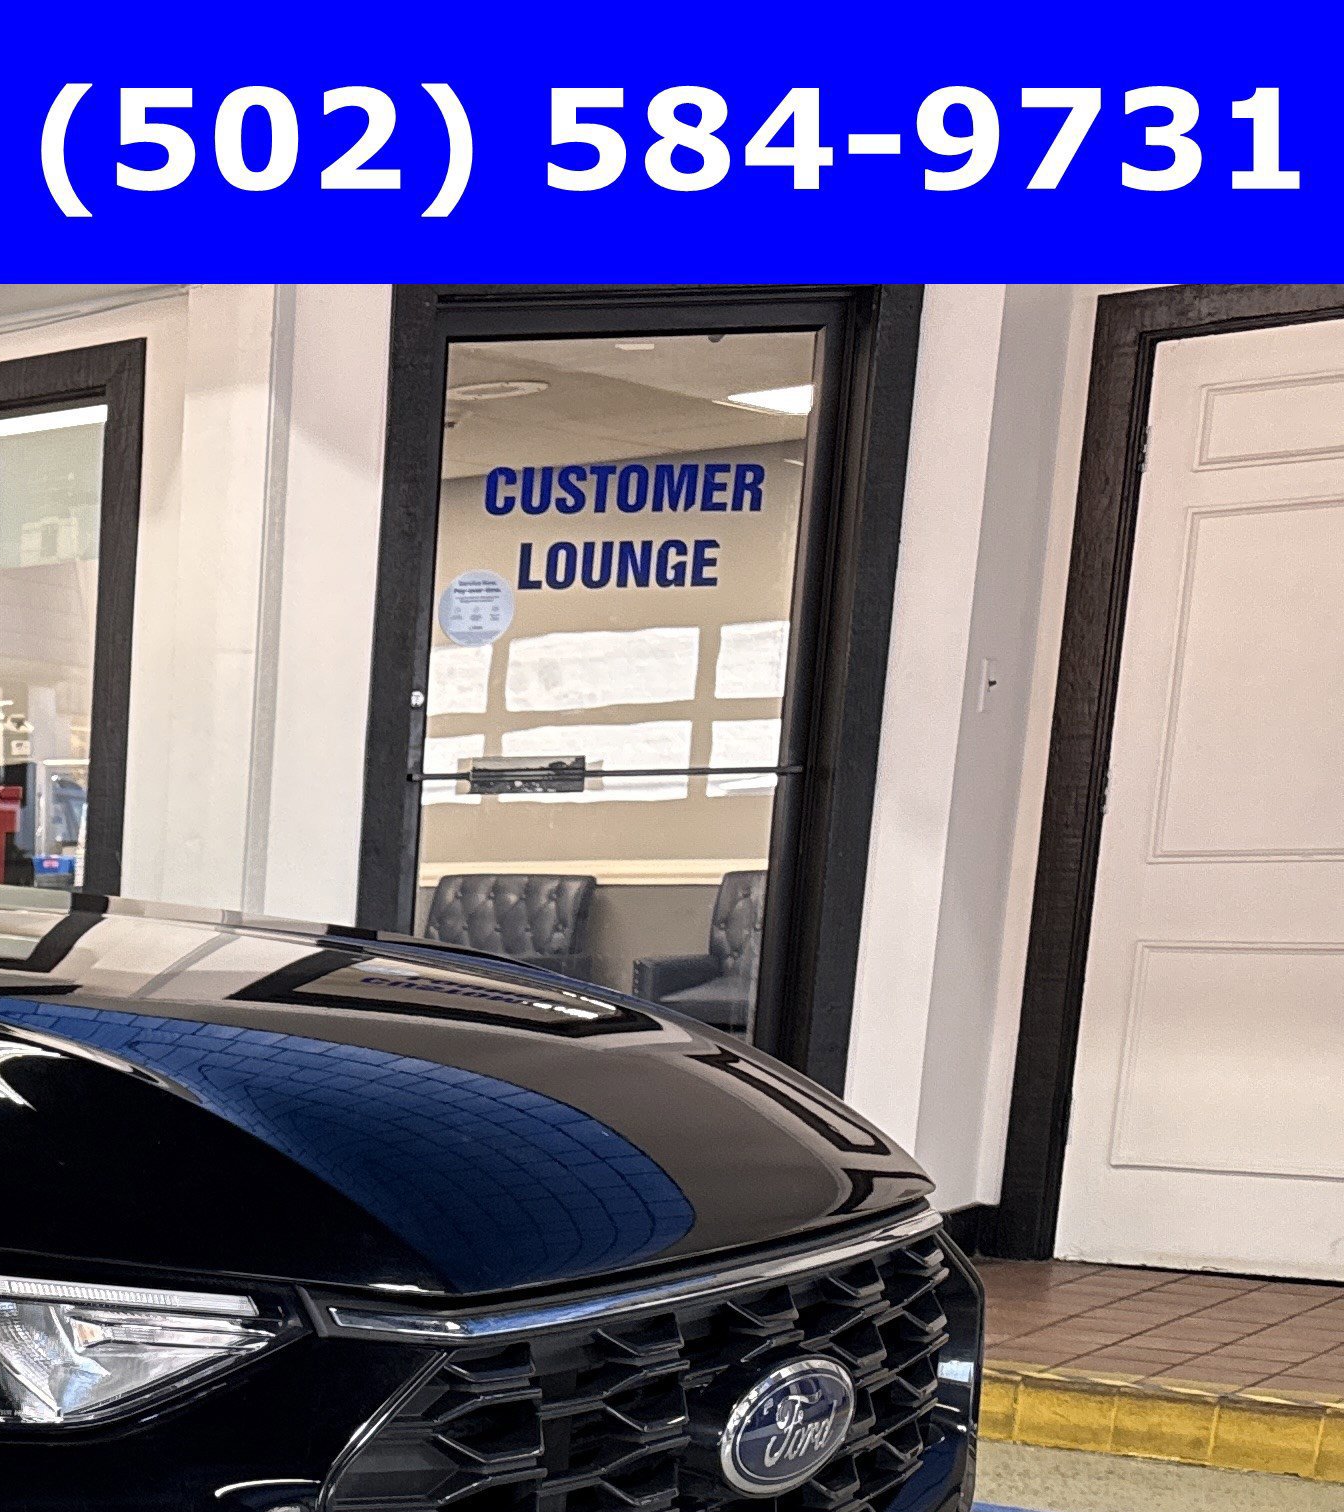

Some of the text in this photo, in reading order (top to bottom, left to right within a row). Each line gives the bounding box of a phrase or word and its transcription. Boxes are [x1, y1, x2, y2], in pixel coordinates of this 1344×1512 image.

[485, 462, 765, 515] CUSTOMER
[517, 539, 720, 590] LOUNGE
[764, 1389, 838, 1467] Ford
